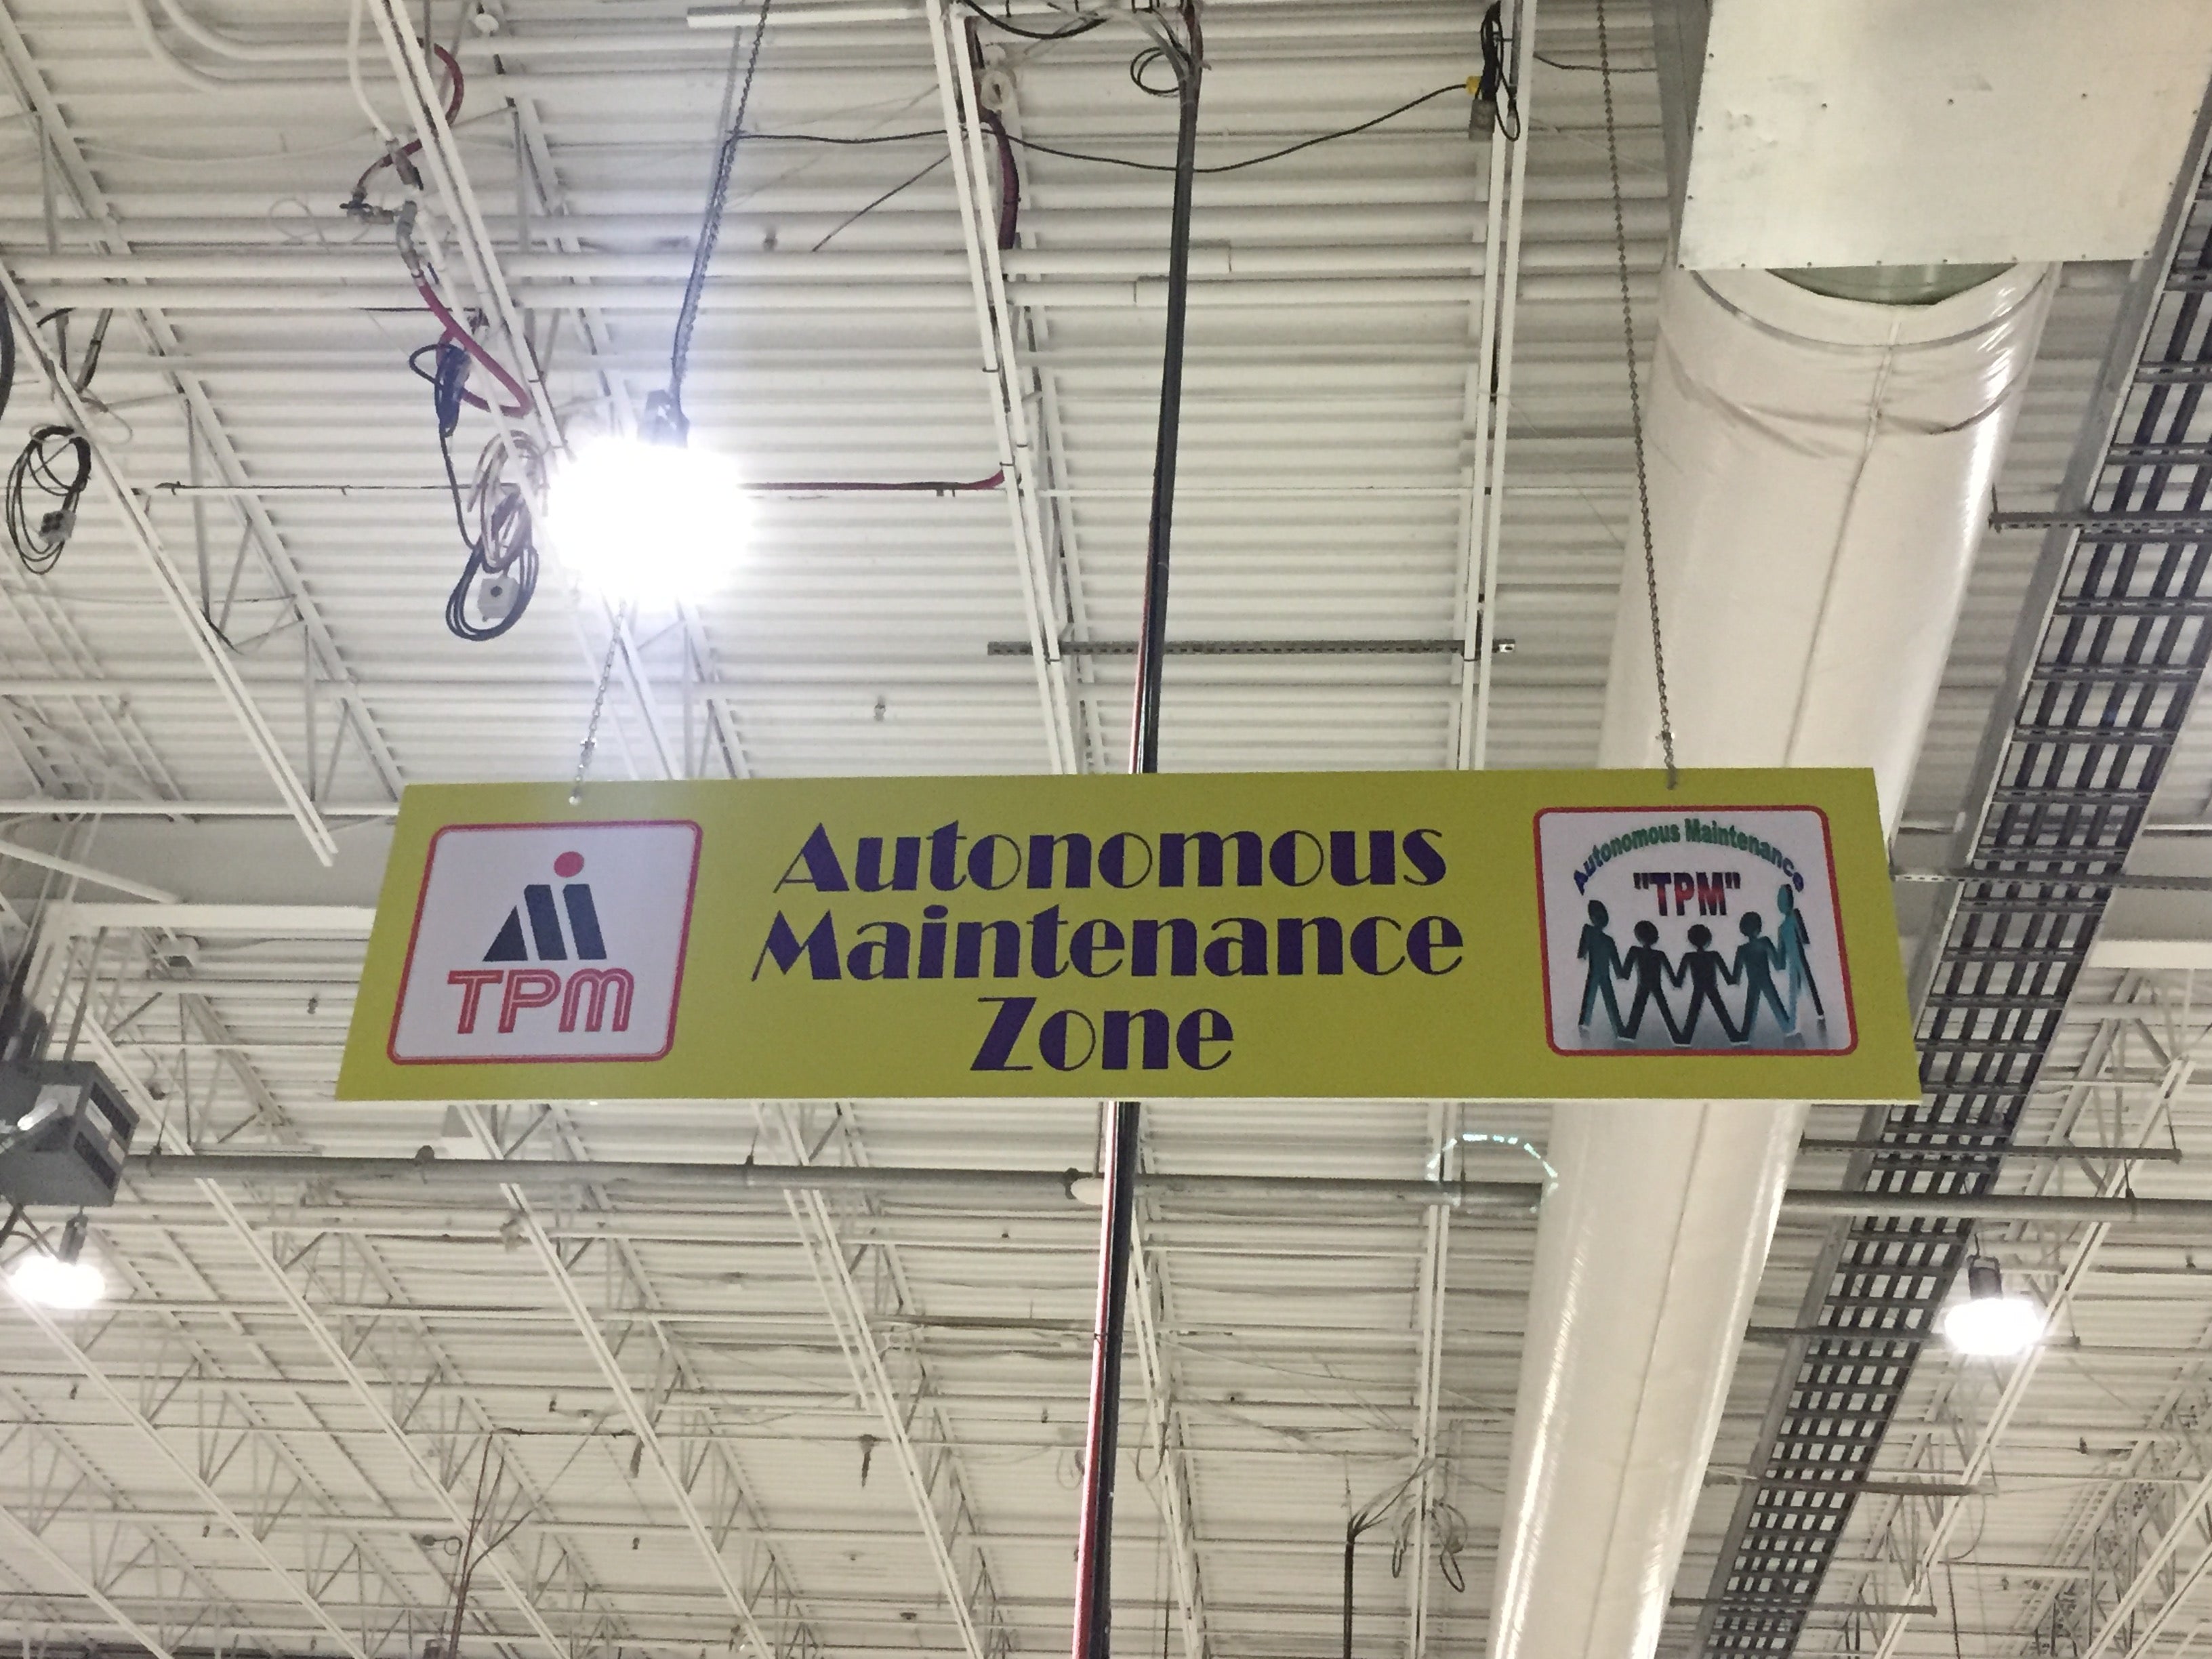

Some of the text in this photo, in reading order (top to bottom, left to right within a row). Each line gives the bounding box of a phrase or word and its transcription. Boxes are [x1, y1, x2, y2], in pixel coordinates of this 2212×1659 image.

[773, 821, 1448, 894] Autonomous
[1574, 818, 1805, 896] Autonomous Maintenance
[1633, 872, 1742, 917] "TPM"
[752, 903, 1464, 982] Maintenance
[447, 968, 634, 1035] TPM
[970, 996, 1235, 1073] Zone
